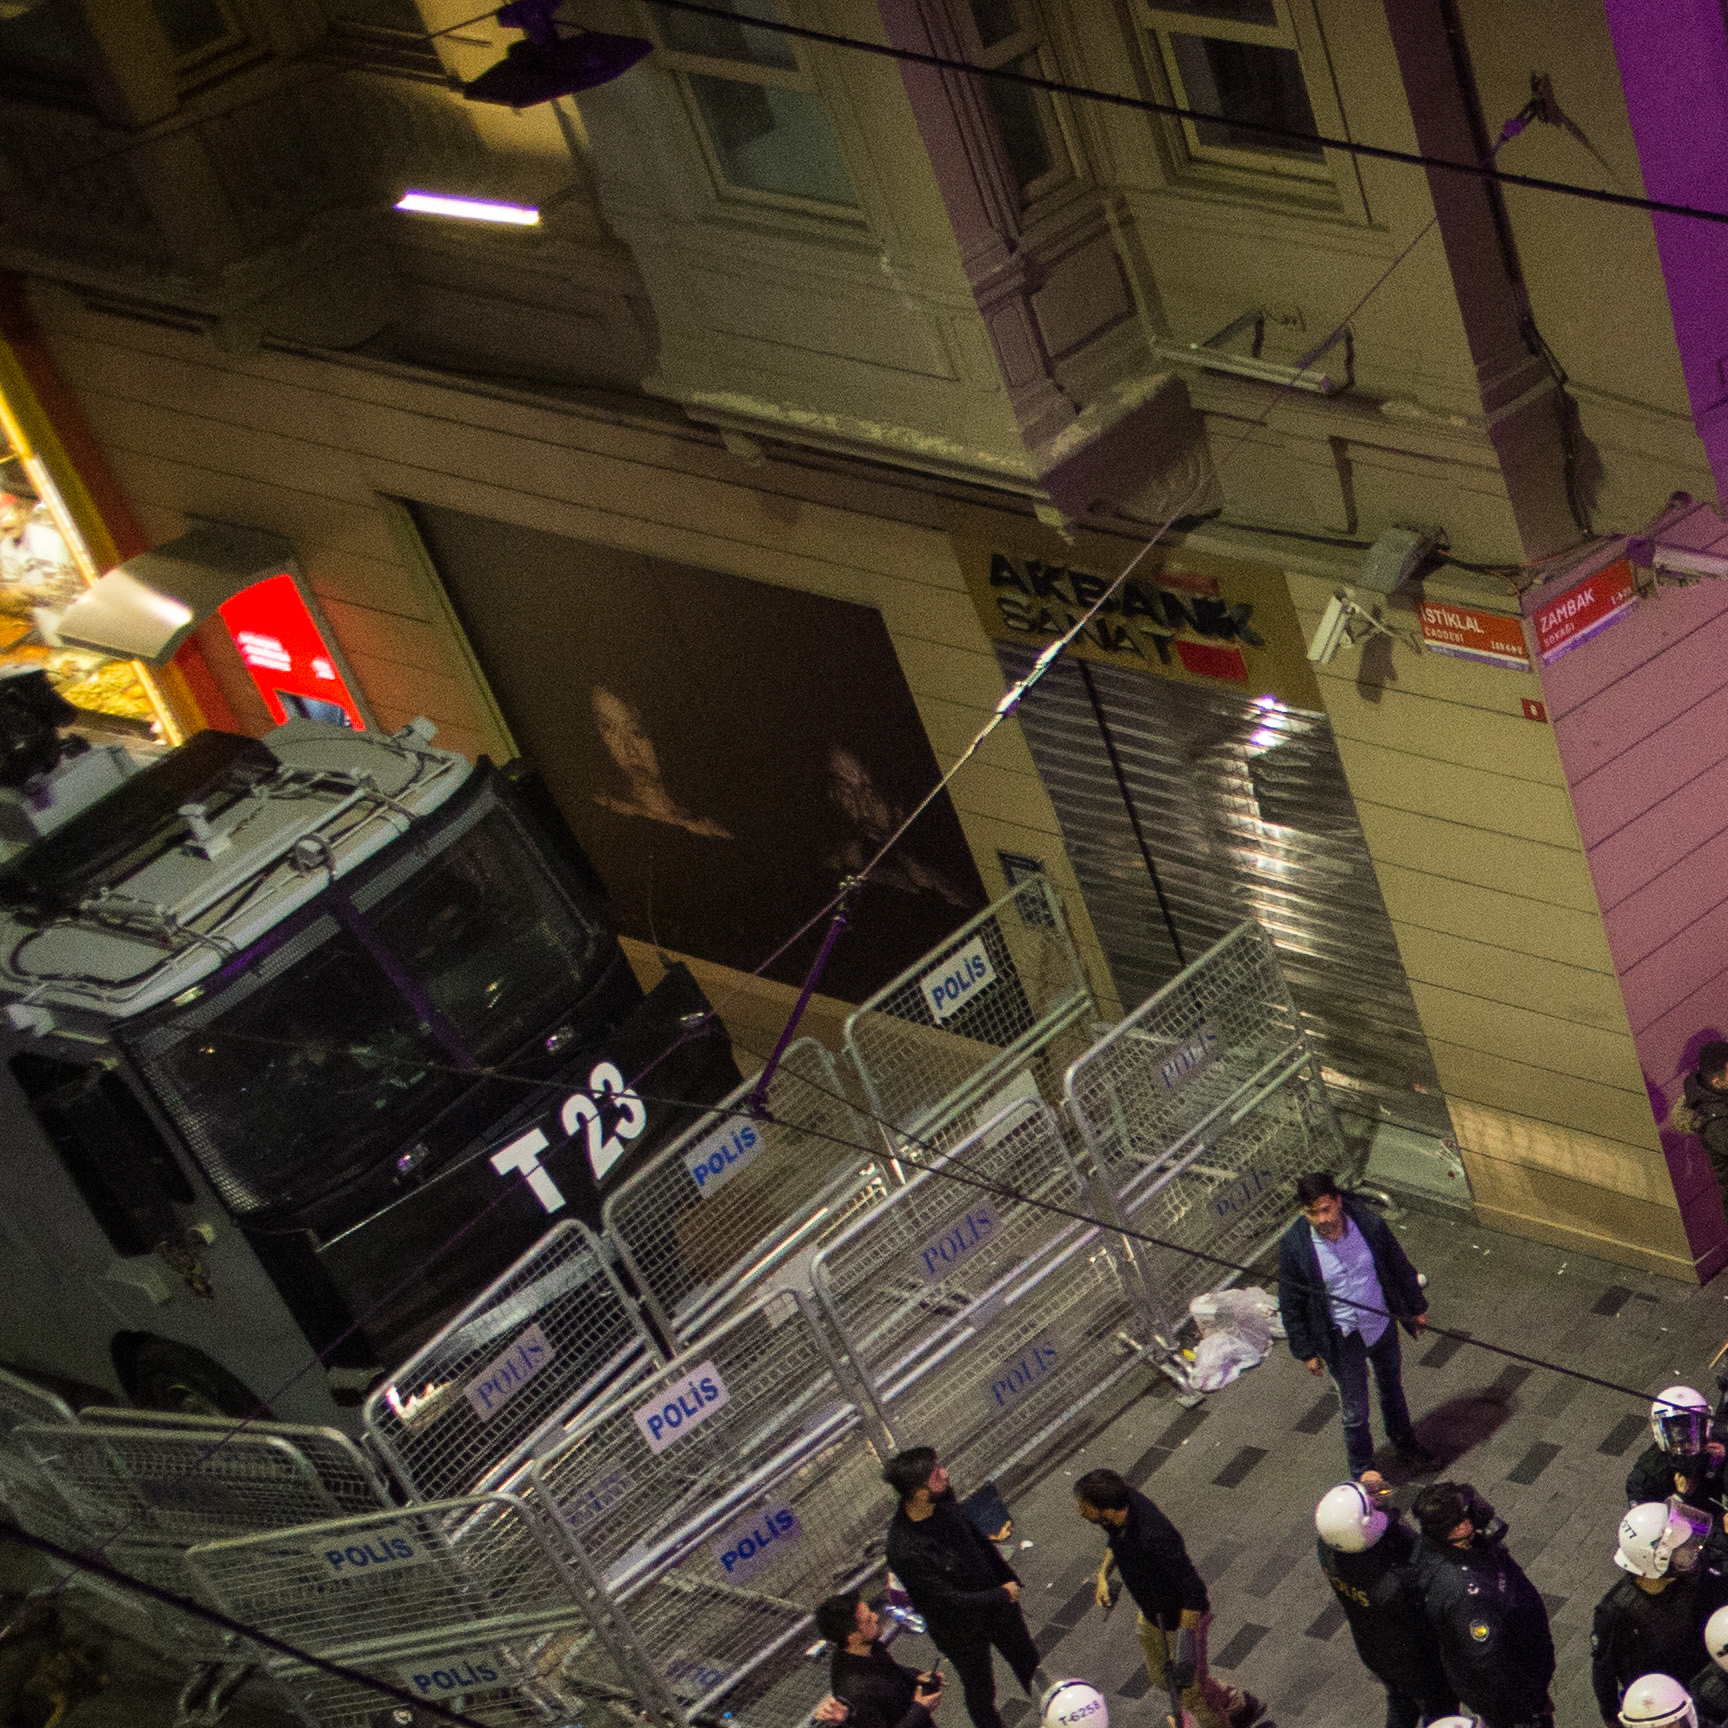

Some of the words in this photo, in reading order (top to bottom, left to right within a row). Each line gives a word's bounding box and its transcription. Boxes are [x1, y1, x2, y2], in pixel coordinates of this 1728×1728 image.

[990, 553, 1265, 646] AKBANK
[1540, 587, 1597, 634] ZAMBAK
[930, 954, 987, 1011] POLİS
[489, 1127, 567, 1213] T
[561, 1062, 647, 1181] 23
[692, 1126, 757, 1187] POLİS
[646, 1377, 719, 1441] POLİS
[324, 1536, 415, 1571] POLİS
[720, 1509, 794, 1573] POLİS
[413, 1660, 500, 1694] POLİS
